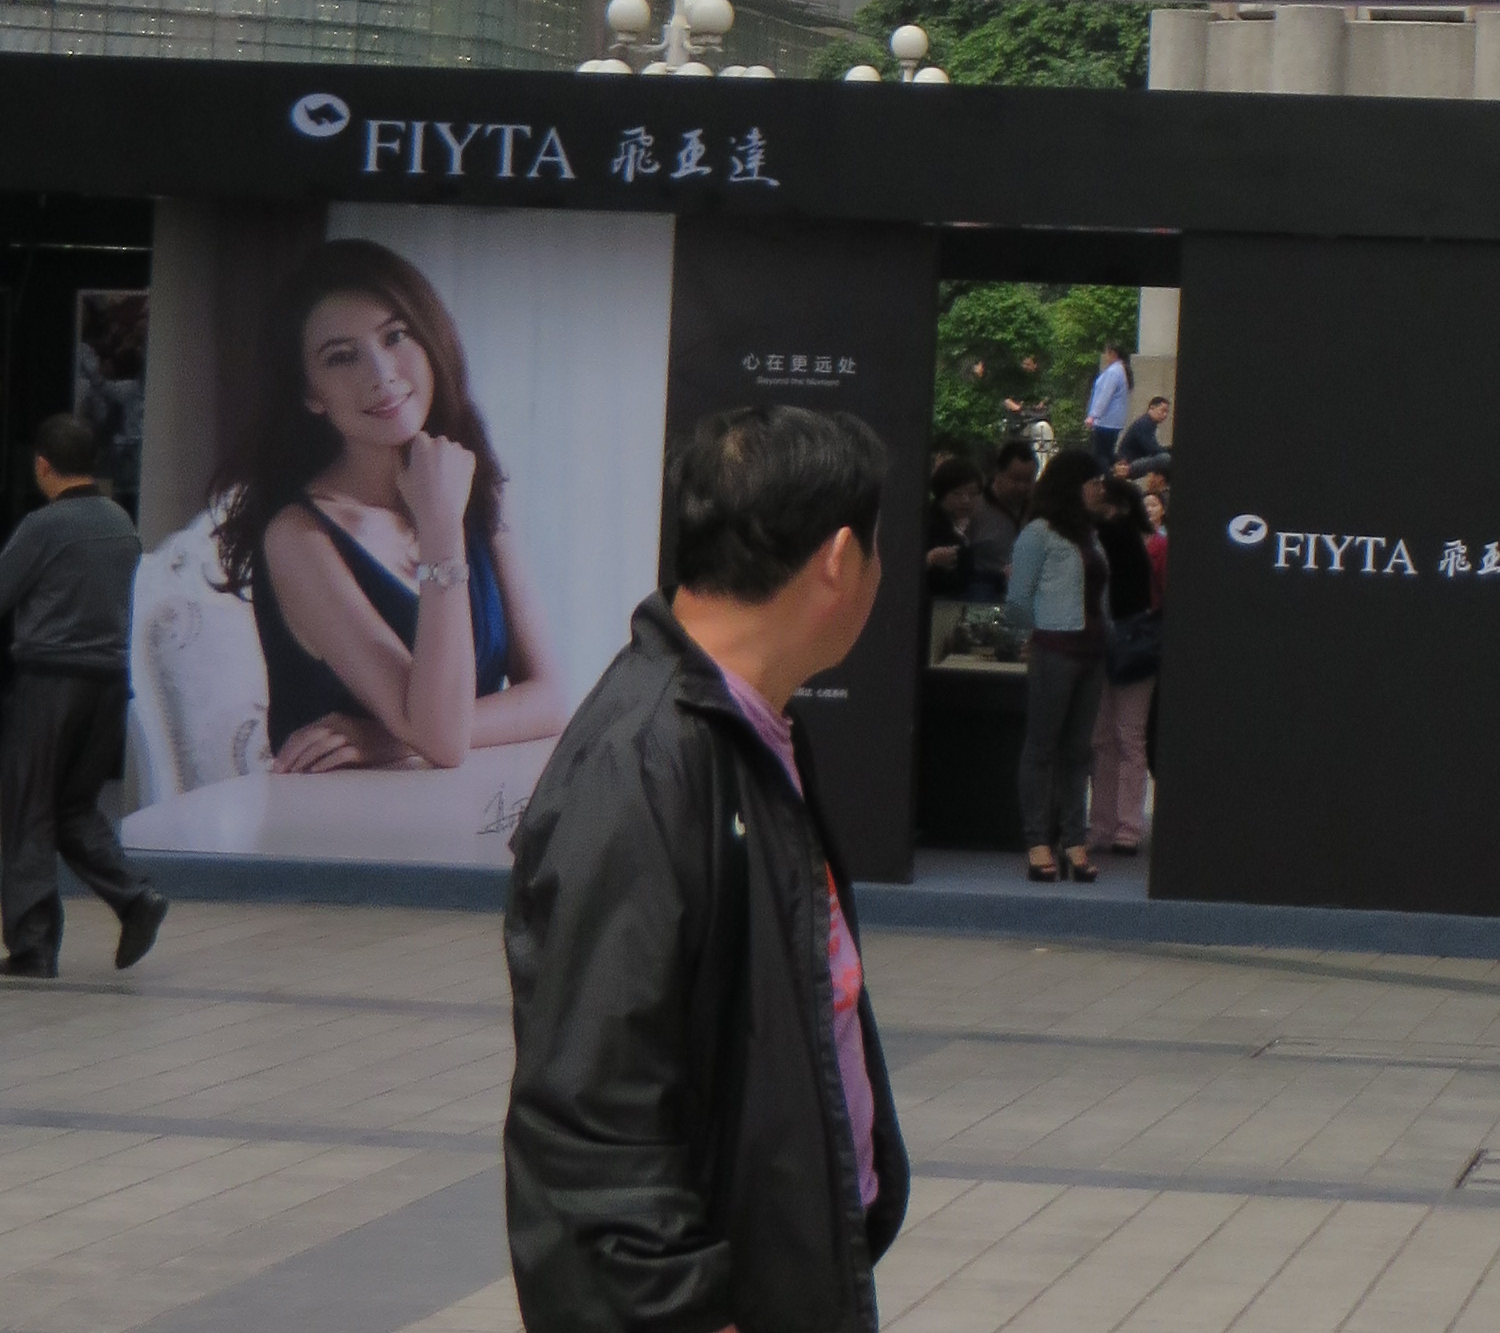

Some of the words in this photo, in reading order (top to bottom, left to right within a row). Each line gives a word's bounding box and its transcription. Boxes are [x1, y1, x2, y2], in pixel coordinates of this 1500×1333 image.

[362, 120, 575, 179] FIYTA
[742, 352, 857, 375] 心在更远处
[1274, 531, 1418, 576] FIYTA
